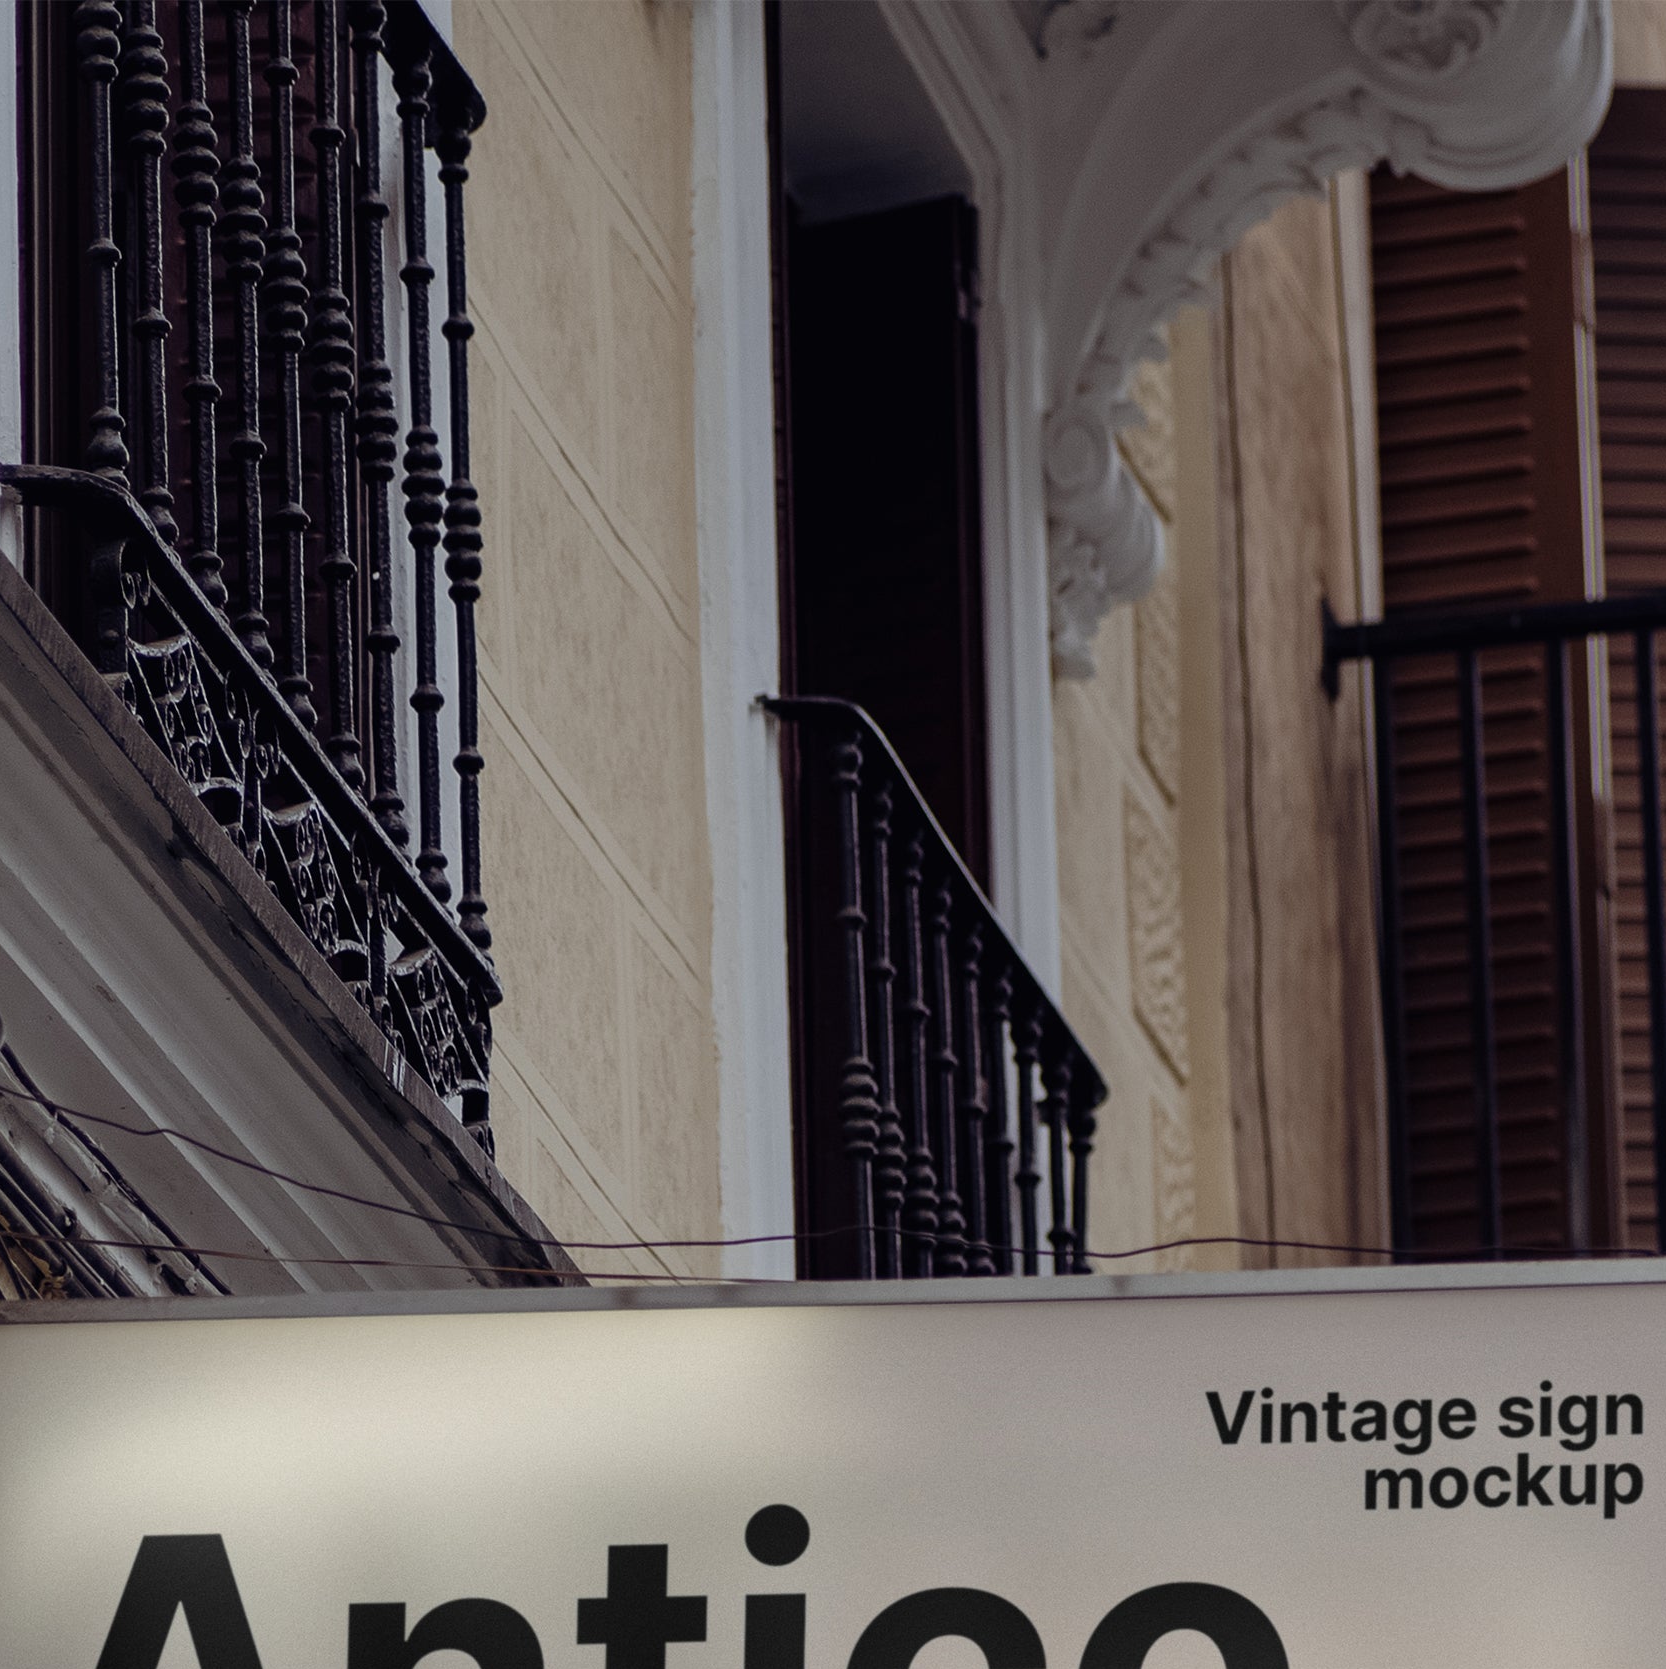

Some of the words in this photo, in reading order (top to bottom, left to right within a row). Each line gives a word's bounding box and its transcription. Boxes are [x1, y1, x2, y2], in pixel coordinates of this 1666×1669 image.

[1204, 1385, 1478, 1456] Vintage
[1497, 1378, 1645, 1452] sign
[1363, 1451, 1645, 1520] mockup
